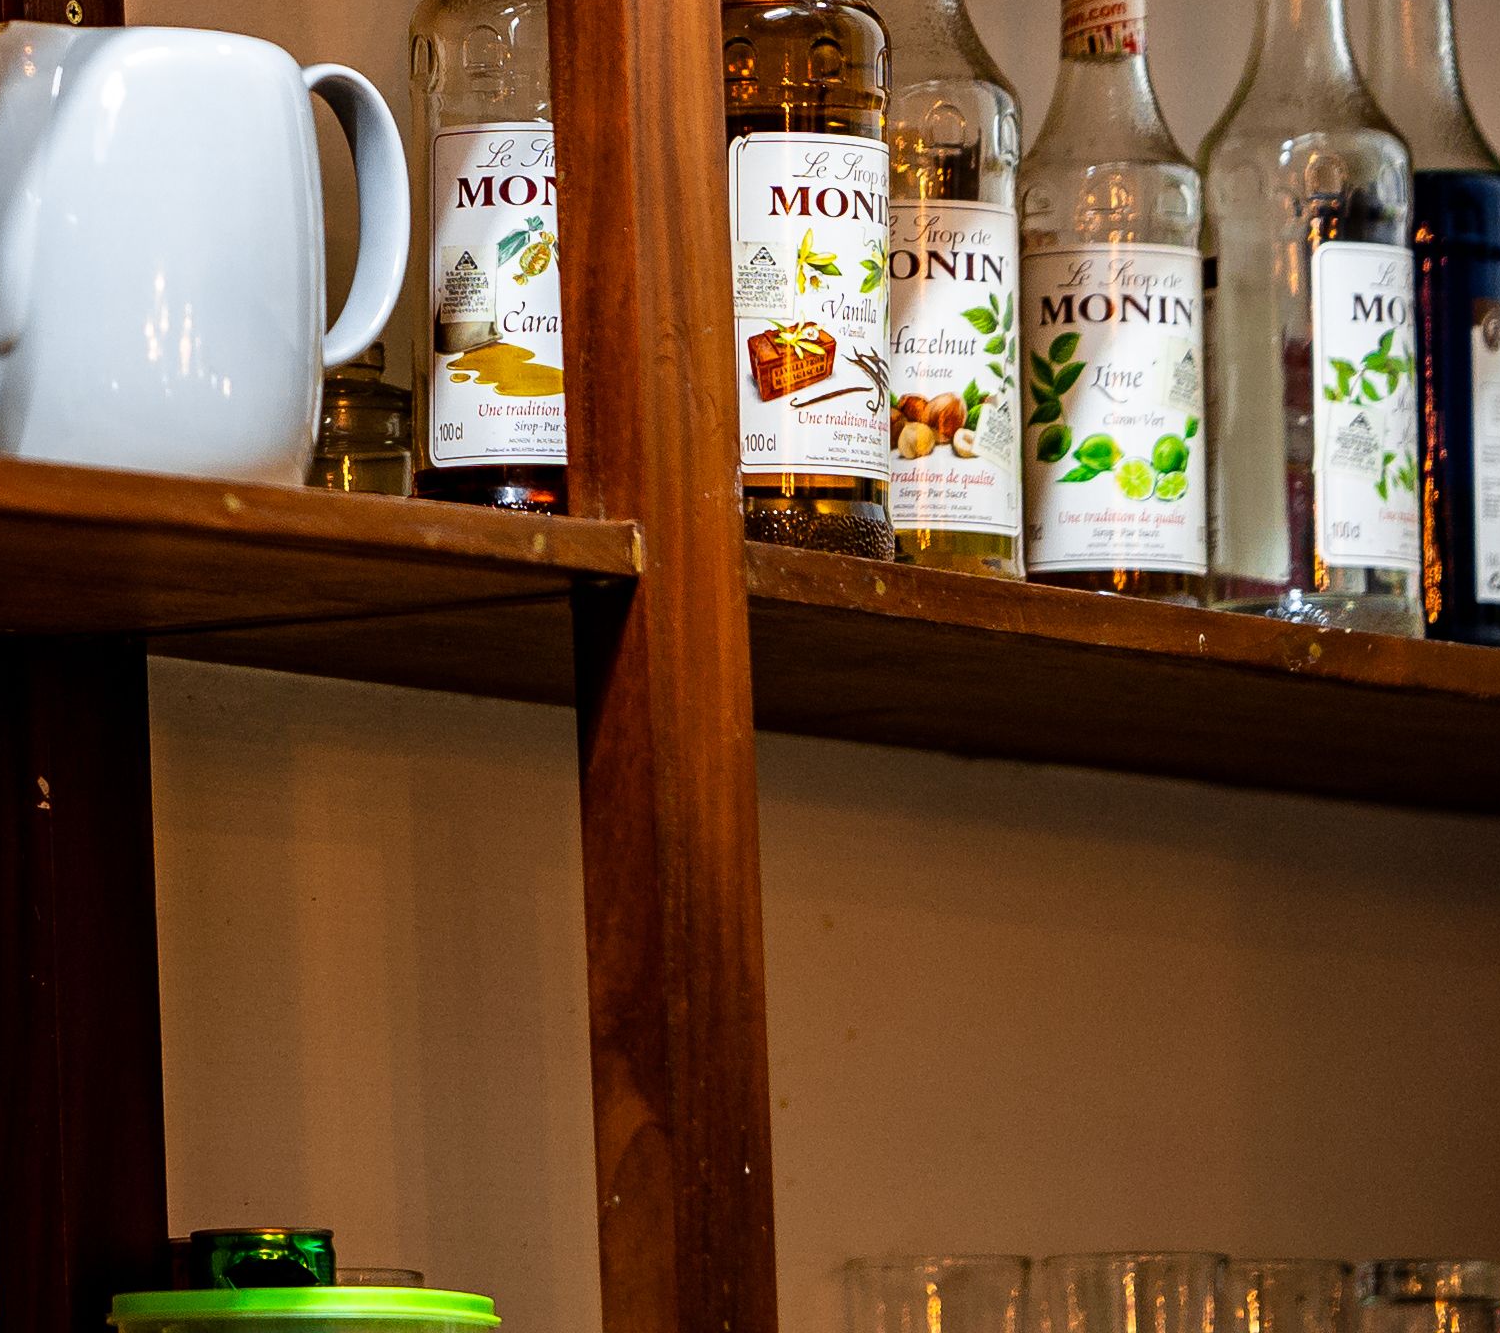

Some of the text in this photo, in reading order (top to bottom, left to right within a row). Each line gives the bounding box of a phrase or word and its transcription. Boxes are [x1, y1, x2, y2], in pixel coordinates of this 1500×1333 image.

[476, 139, 515, 167] Le
[792, 151, 830, 179] Le
[834, 152, 878, 190] Sirop
[904, 214, 965, 250] Sirop
[970, 229, 992, 246] de
[889, 249, 1005, 284] ONIN
[1058, 259, 1182, 295] Le Sirop de
[503, 301, 560, 333] Cara
[821, 293, 877, 324] Vanilla
[1040, 293, 1194, 328] MONIN
[905, 362, 953, 379] Noisette
[1091, 362, 1144, 404] Lime
[478, 400, 560, 417] Une tradition
[798, 411, 823, 425] Une
[825, 410, 867, 428] tradition
[946, 468, 958, 484] de
